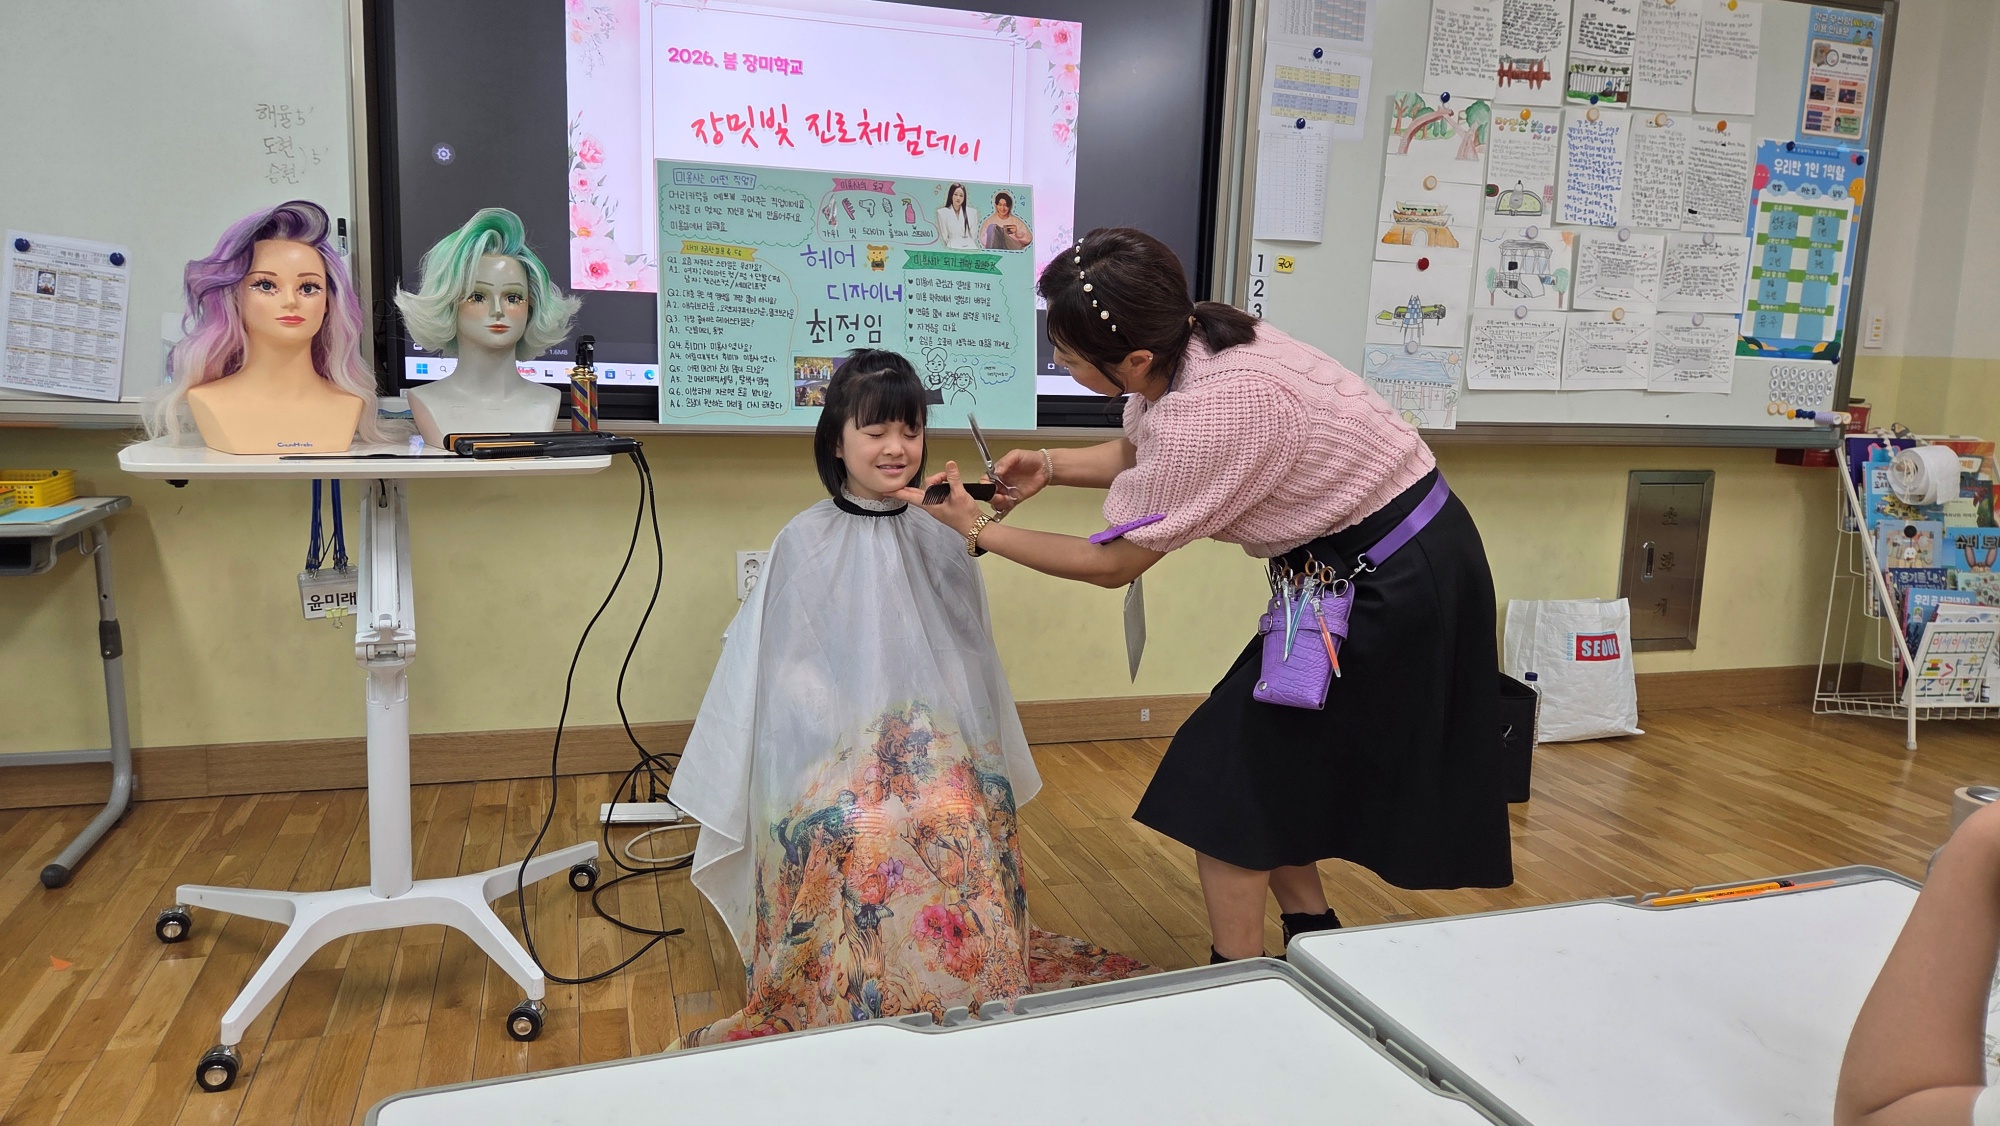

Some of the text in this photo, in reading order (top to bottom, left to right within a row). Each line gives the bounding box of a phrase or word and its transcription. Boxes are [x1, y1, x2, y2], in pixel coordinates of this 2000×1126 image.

[667, 47, 804, 75] 2026. 봄 장미학교
[691, 103, 980, 163] 장밋빛 진로체험데이
[676, 171, 754, 187] 미용사는 어떤 직업?
[1805, 162, 1820, 178] 1인
[1823, 164, 1845, 181] 1역할
[840, 182, 866, 190] 미용사의
[668, 190, 709, 202] 머리카락을
[771, 197, 805, 209] 직업이에요
[669, 205, 691, 214] 사람을
[670, 220, 703, 231] 미용실에서
[822, 229, 839, 238] 가위
[849, 227, 856, 239] 빗
[800, 244, 855, 270] 헤어
[914, 254, 939, 266] 미용사가
[1258, 254, 1263, 273] 1
[667, 288, 682, 297] Q2.
[827, 282, 902, 302] 디자이너
[1254, 279, 1264, 297] 2
[666, 300, 679, 308] A2.
[916, 292, 927, 302] 미용
[1253, 303, 1262, 319] 3
[665, 315, 680, 323] Q3.
[806, 308, 881, 344] 최정임
[943, 323, 957, 332] 따요
[684, 340, 707, 351] 취미가
[669, 387, 684, 396] Q6.
[685, 387, 712, 396] 이상하게
[670, 400, 683, 408] A6.
[747, 401, 760, 409] 다시
[1954, 534, 1979, 549] 슈퍼
[307, 592, 357, 612] 윤미래
[1581, 637, 1619, 657] SEOUL
